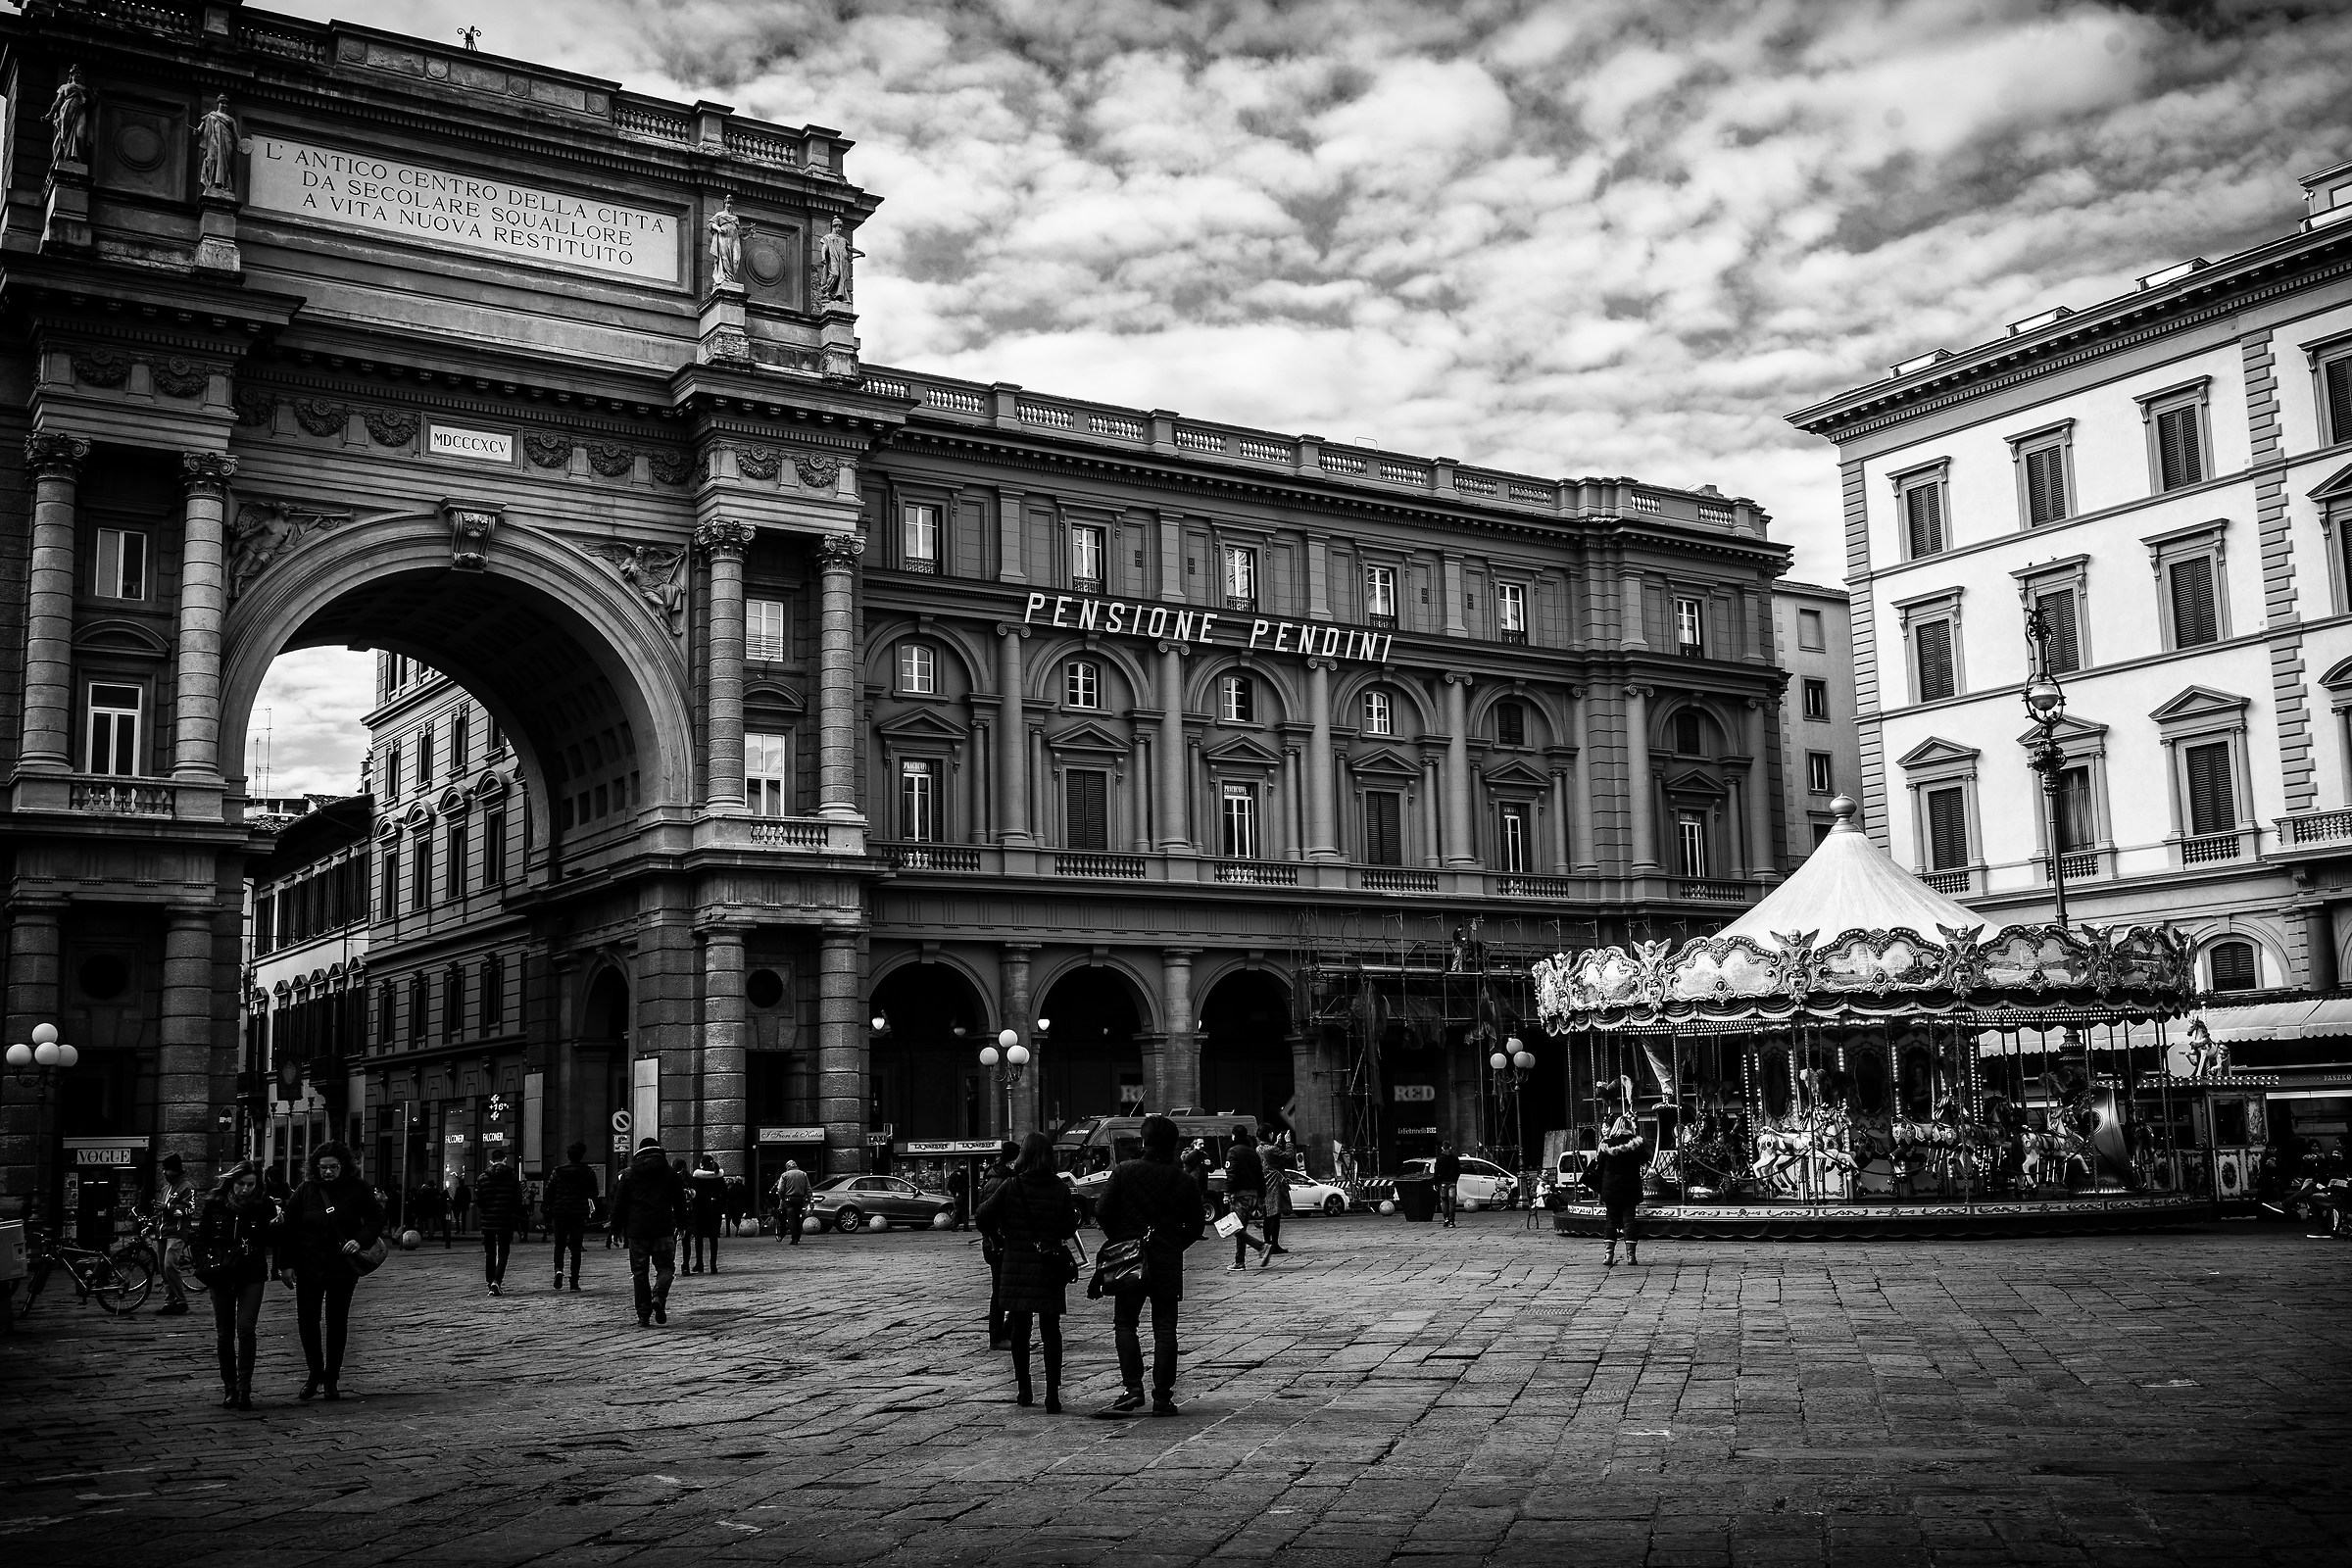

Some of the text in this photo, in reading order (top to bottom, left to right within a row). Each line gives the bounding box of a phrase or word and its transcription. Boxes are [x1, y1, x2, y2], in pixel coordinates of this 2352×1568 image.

[295, 149, 388, 180] ANTICO
[398, 169, 498, 201] CENTRO
[508, 189, 588, 220] DELLA
[597, 208, 665, 234] CITTÀ
[302, 170, 633, 247] DA SECOLARE SQUALLORE
[302, 192, 634, 266] A VITA NUOVA RESTITUITO
[433, 432, 508, 454] MDCCCXCV
[1023, 592, 1393, 663] PENSIONE PENDINI
[1394, 1085, 1436, 1102] RED
[77, 1150, 130, 1163] VOGUE
